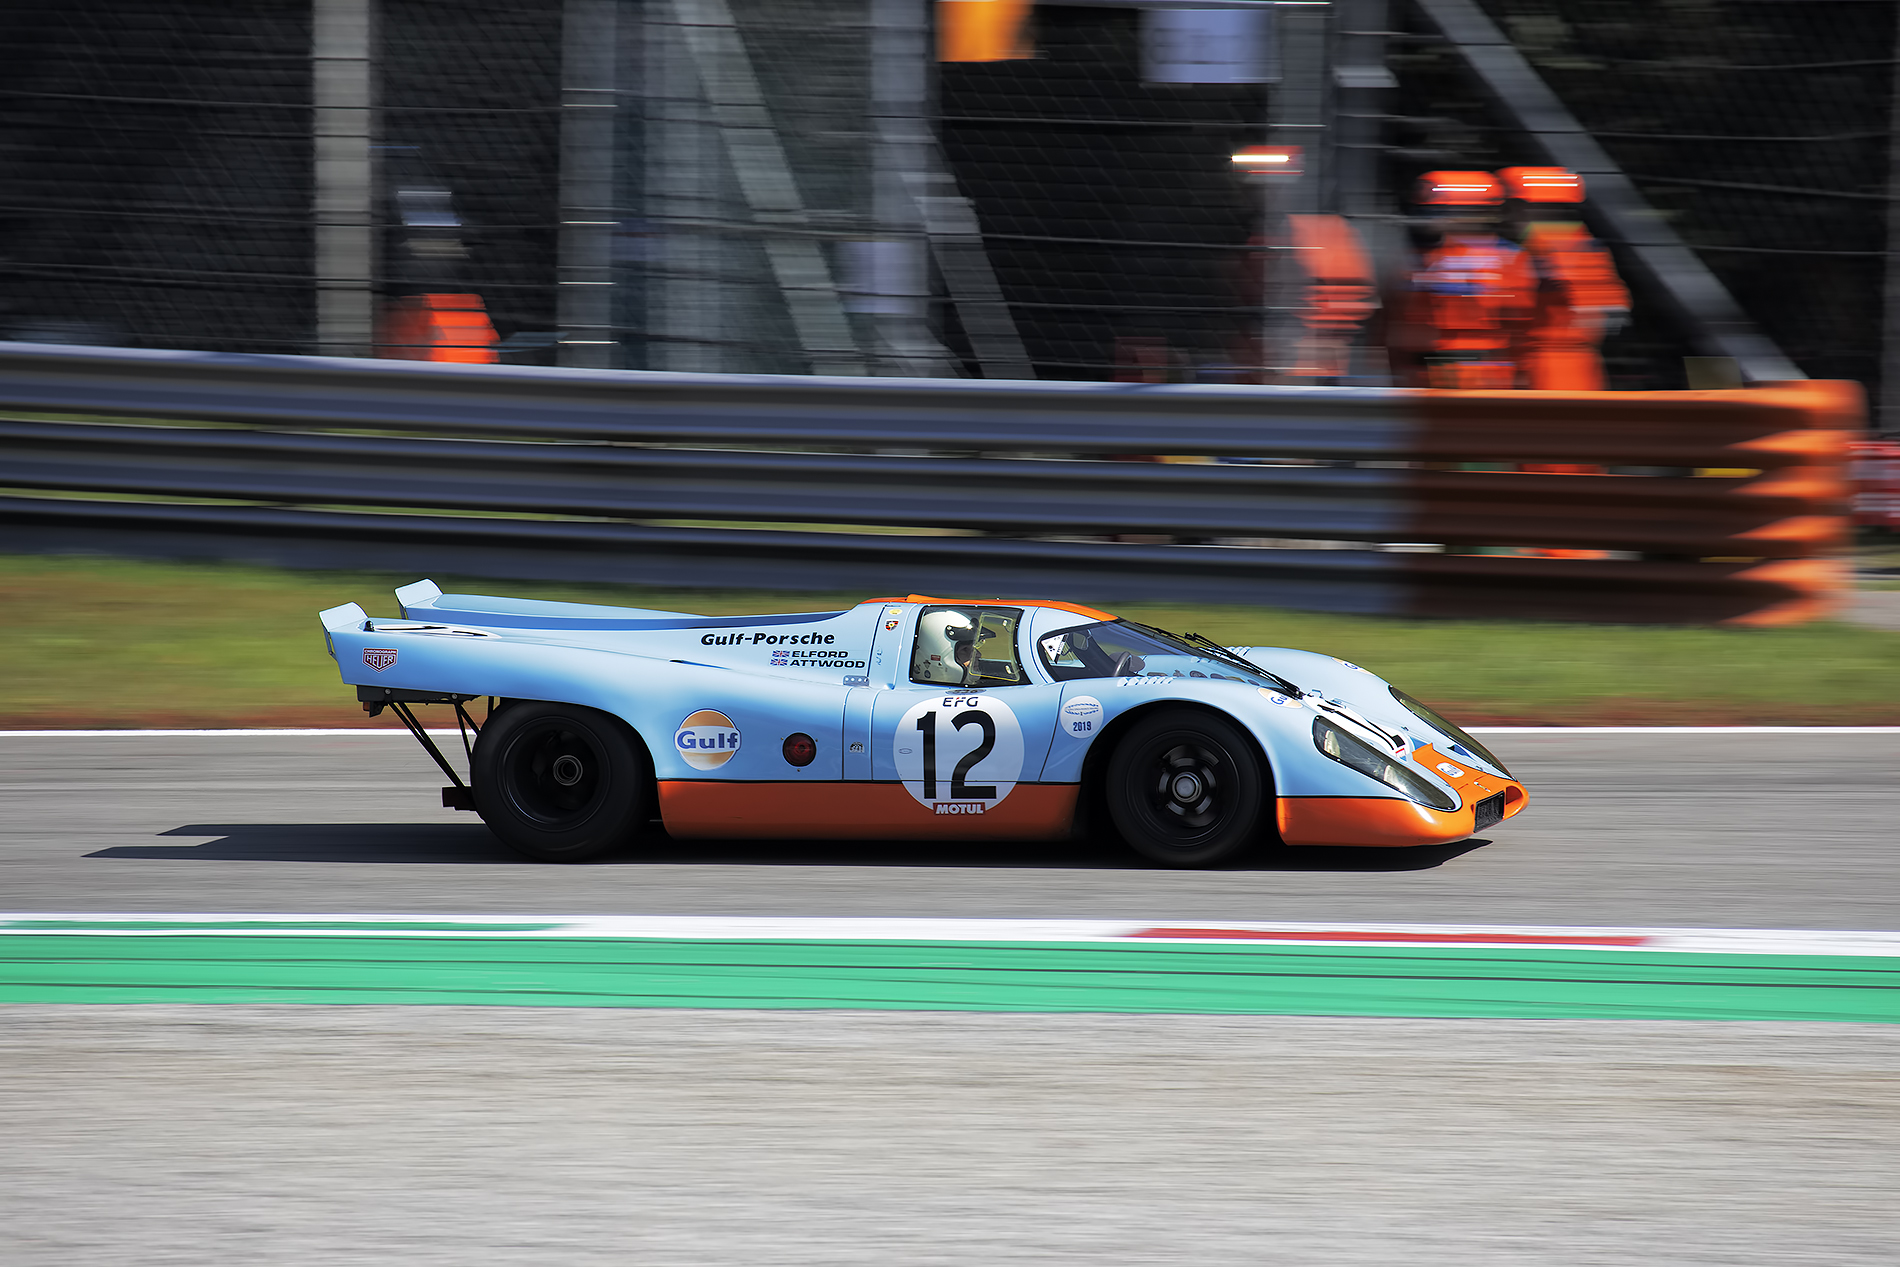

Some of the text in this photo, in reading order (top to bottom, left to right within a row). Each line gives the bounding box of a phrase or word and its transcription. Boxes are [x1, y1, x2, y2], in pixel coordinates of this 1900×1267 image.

[700, 631, 835, 646] Gulf-Porsche
[791, 650, 849, 658] ELFORD
[364, 654, 396, 668] HEUER
[789, 659, 866, 668] ATTWOOD
[942, 696, 979, 707] EFG
[1072, 720, 1092, 732] 2019
[677, 730, 739, 750] Gulf
[916, 709, 997, 799] 12
[935, 803, 984, 815] MOTUL
